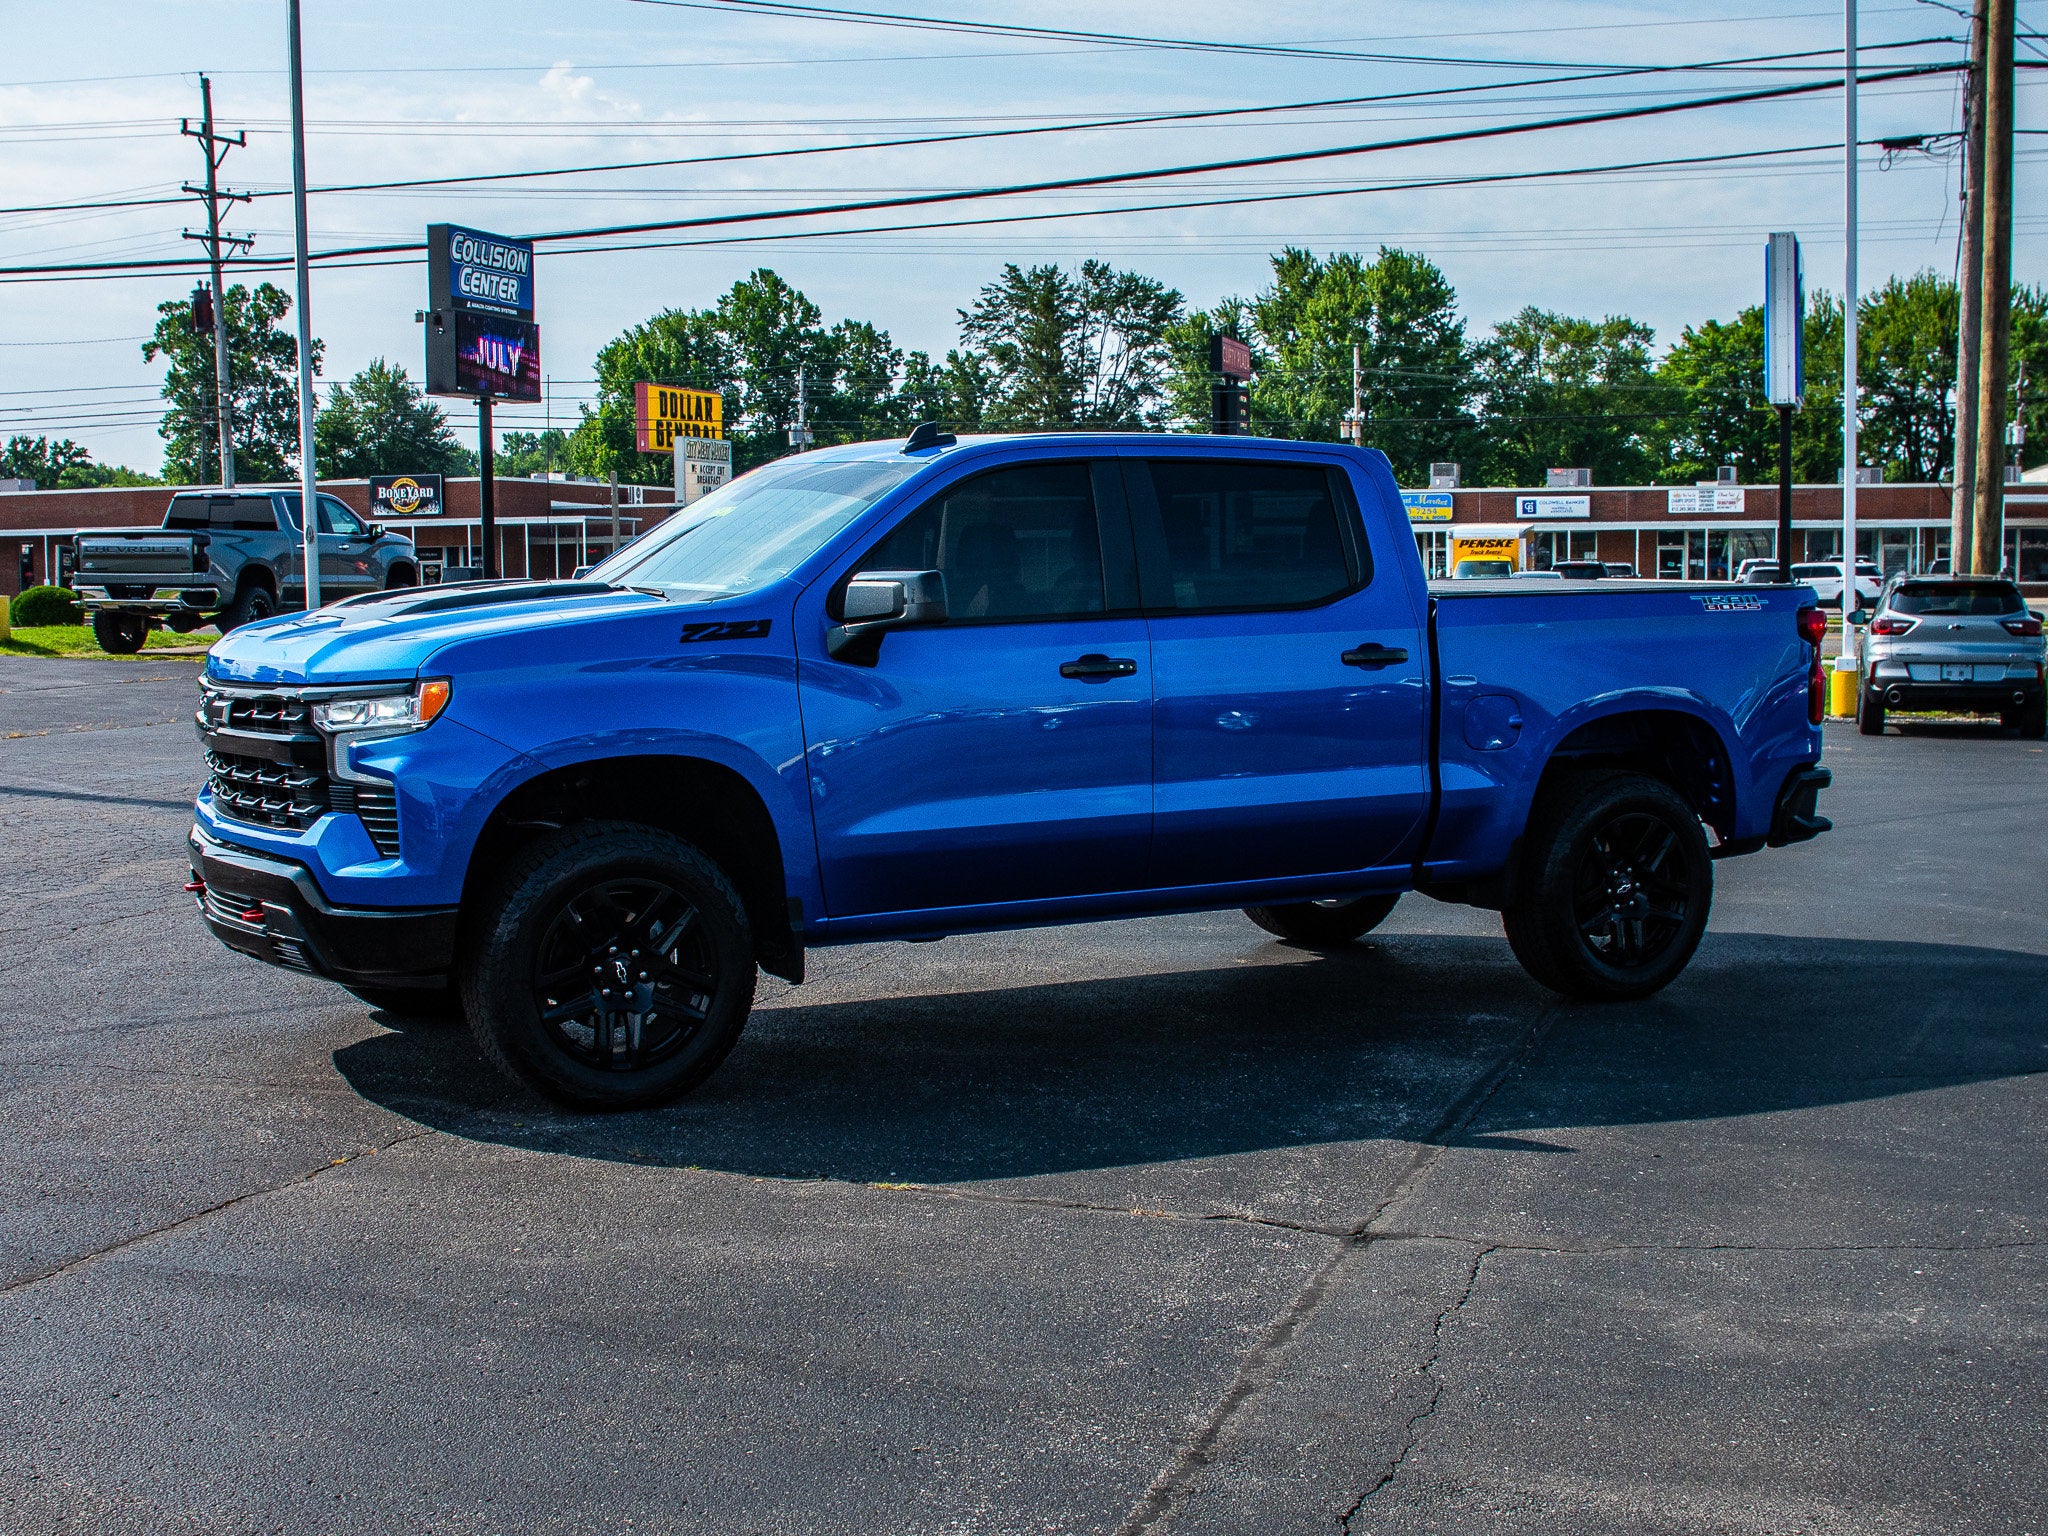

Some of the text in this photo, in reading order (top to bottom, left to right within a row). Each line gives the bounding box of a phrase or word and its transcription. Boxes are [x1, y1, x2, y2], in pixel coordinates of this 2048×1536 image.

[451, 232, 530, 275] COLLISION
[460, 266, 519, 304] CENTER
[474, 336, 522, 376] JULY
[658, 390, 713, 423] DOLLAR
[686, 440, 730, 461] CITY MEAT MARKET
[691, 464, 725, 476] WE ACCEPT EBT
[697, 475, 721, 485] BREAKFAST
[84, 545, 183, 553] CHEVROLET
[1459, 539, 1515, 548] PENSKE
[1689, 594, 1769, 604] TRAIL
[1703, 603, 1762, 612] BOSS
[679, 618, 773, 644] Z71
